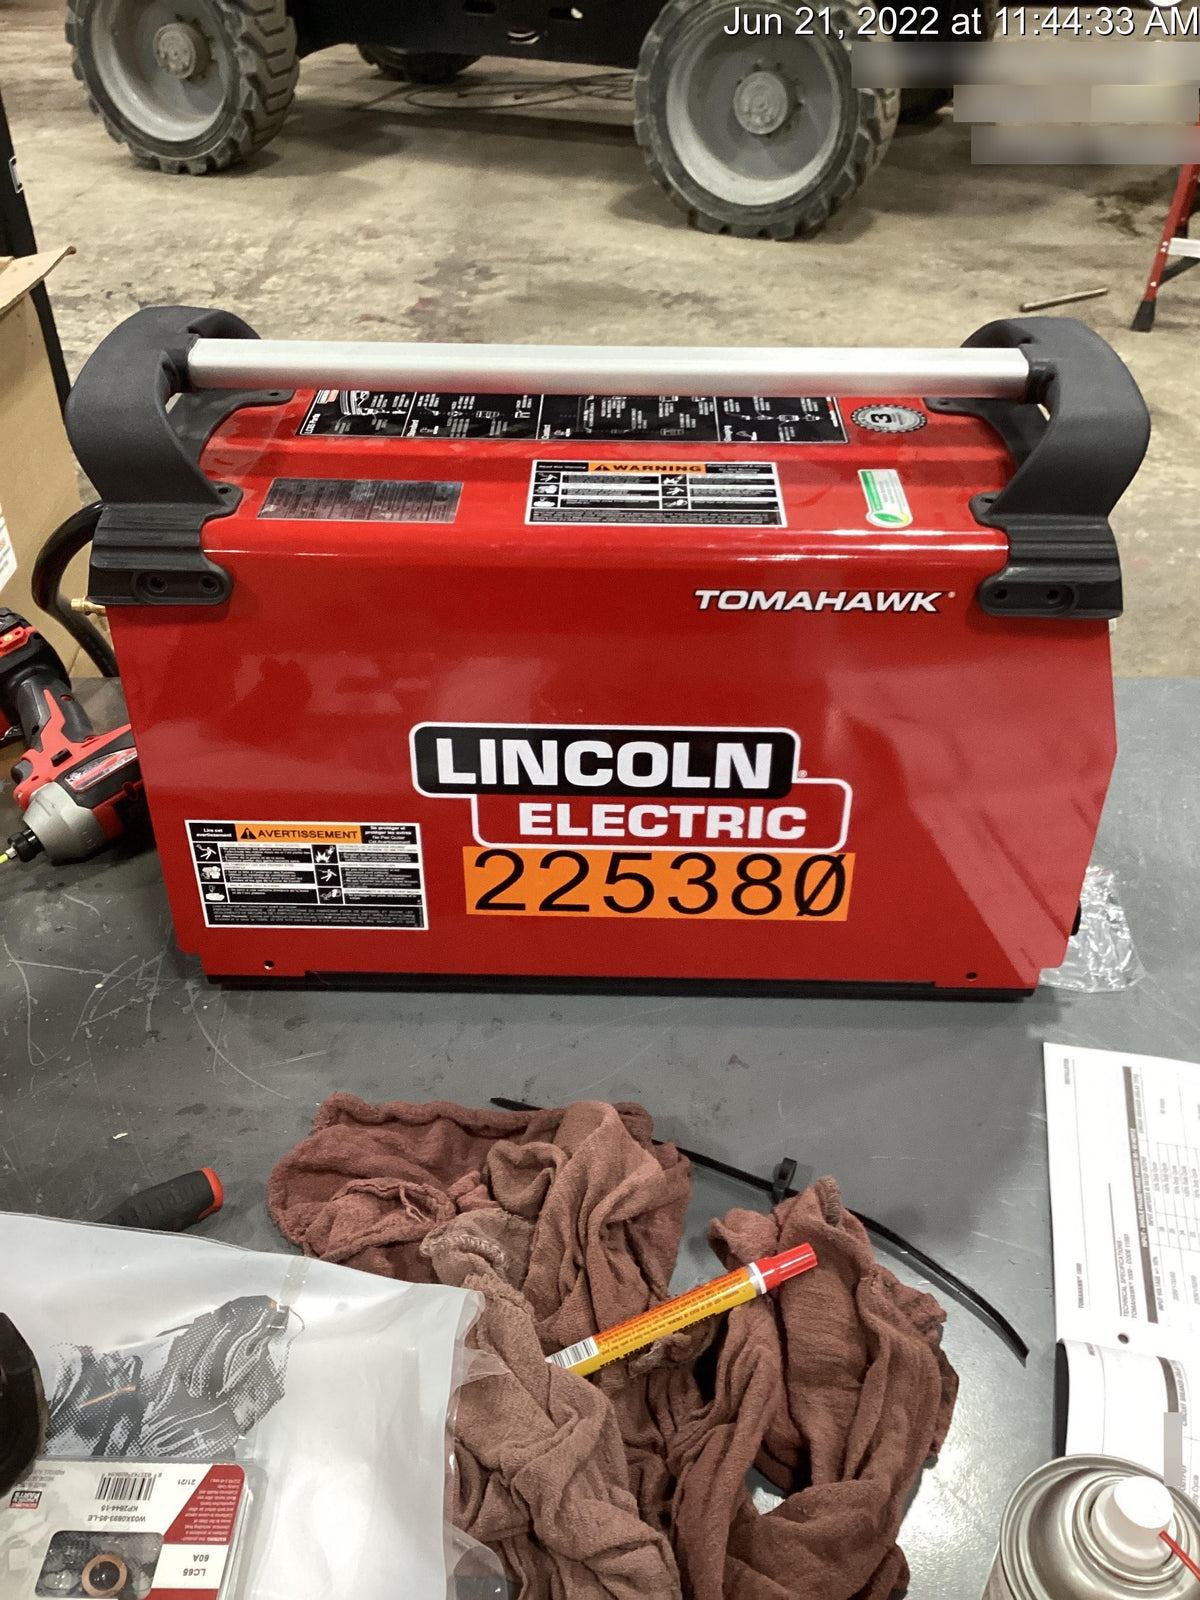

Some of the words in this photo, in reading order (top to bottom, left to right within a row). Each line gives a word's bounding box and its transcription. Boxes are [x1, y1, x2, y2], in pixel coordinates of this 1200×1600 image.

[870, 413, 893, 424] 3
[613, 464, 702, 472] WARNING
[436, 737, 773, 790] LINCOLN
[519, 803, 806, 840] ELECTRIC
[258, 829, 358, 839] AVERTISSEMENT
[1116, 1240, 1126, 1285] SPECIFICATIONS
[1154, 1276, 1162, 1297] VOLTAGE
[1121, 1286, 1130, 1317] TECHNICAL
[1178, 1380, 1186, 1402] BREAKER
[193, 1554, 210, 1562] 60A
